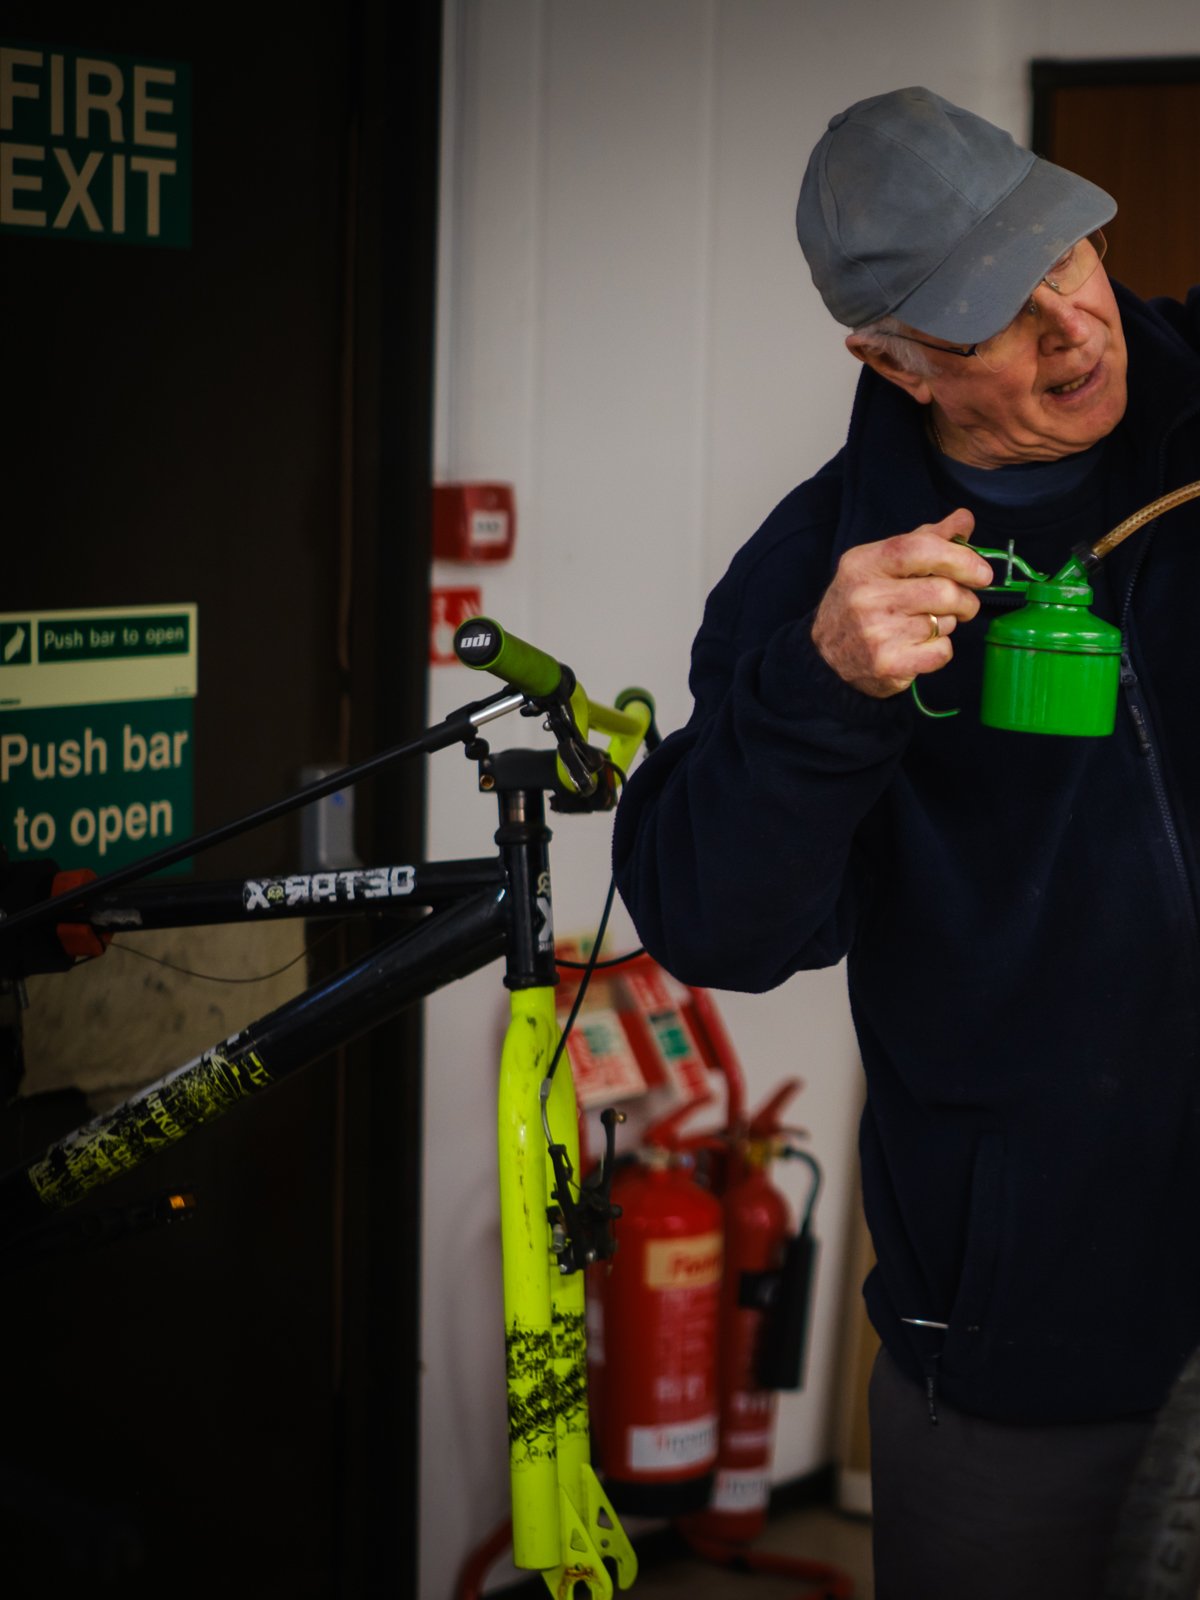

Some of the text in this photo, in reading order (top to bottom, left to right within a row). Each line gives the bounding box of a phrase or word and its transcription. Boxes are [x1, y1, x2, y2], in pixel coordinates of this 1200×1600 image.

[0, 47, 177, 149] FIRE
[0, 142, 177, 237] EXIT
[44, 626, 184, 650] Push bar to open
[460, 633, 492, 649] odi
[1, 724, 188, 783] Push bar
[14, 799, 173, 856] to open
